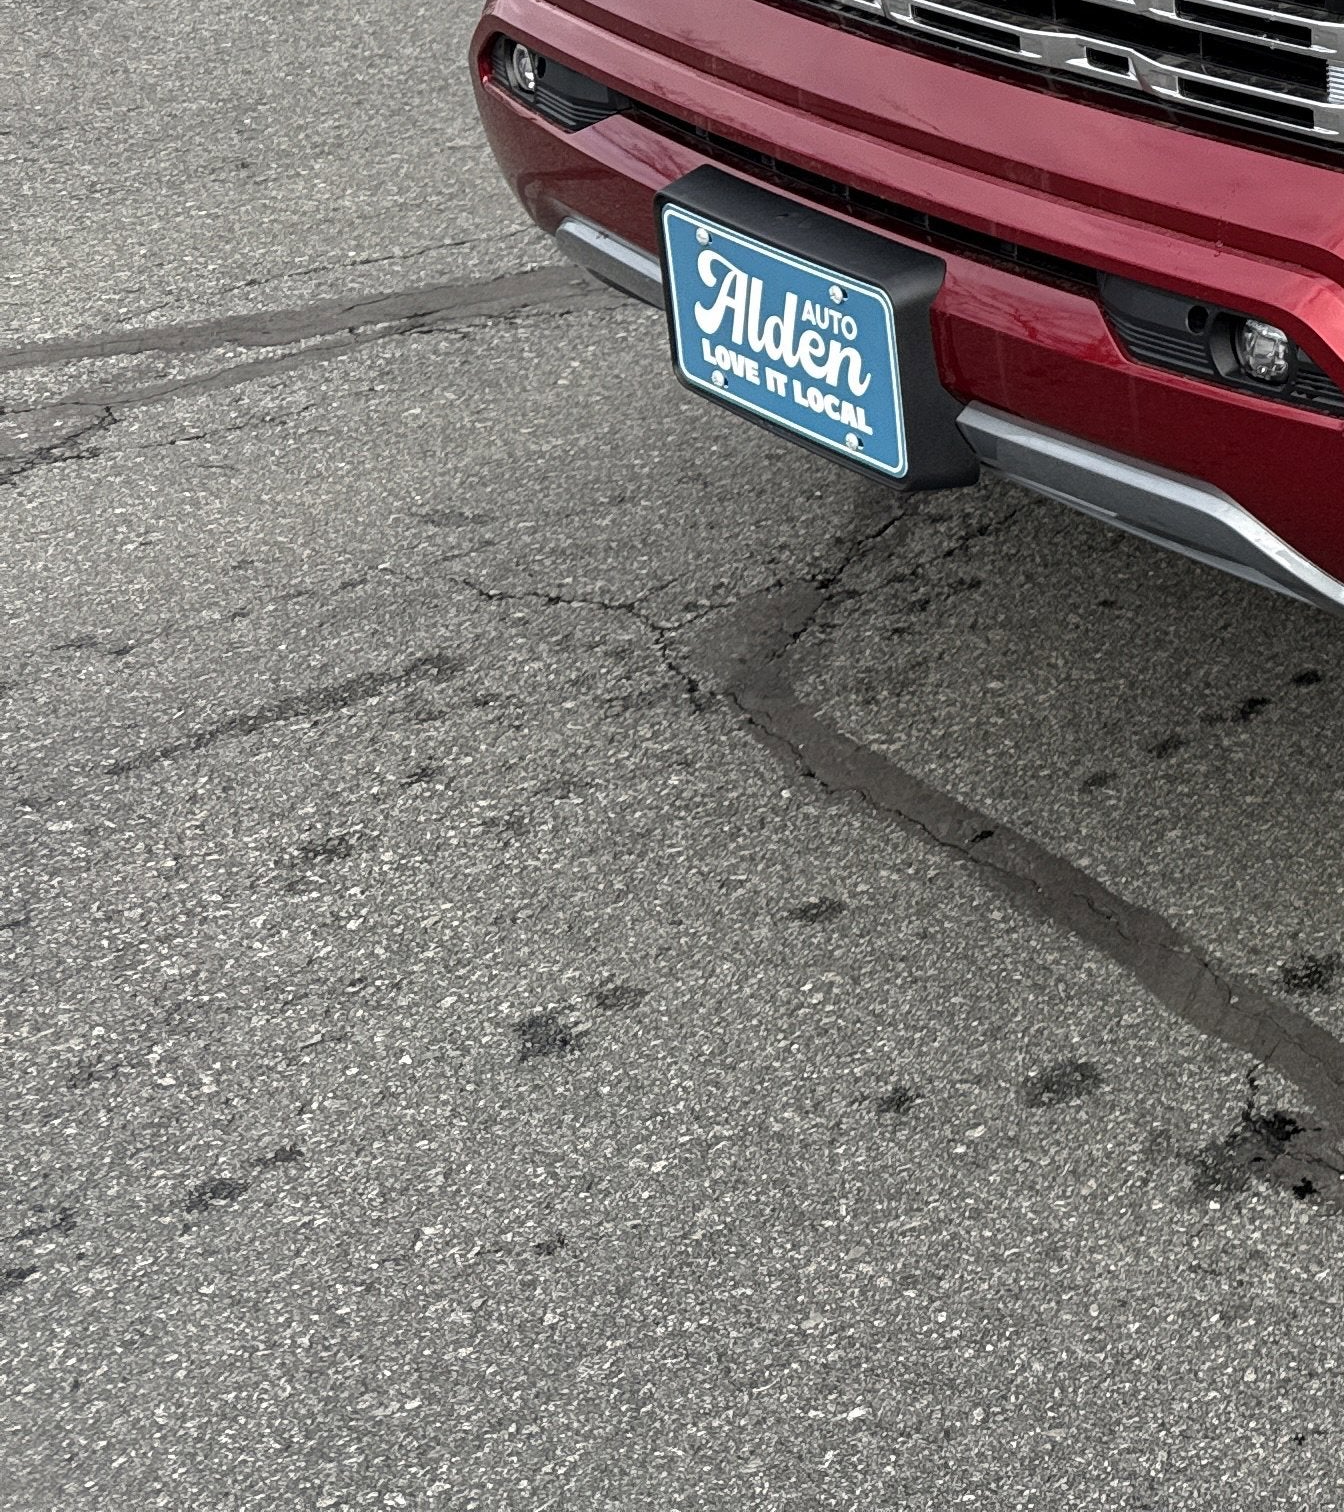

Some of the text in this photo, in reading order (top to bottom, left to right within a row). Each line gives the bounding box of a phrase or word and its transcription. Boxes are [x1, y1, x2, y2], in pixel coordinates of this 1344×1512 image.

[694, 249, 871, 396] Alden
[801, 300, 858, 340] AUTO
[702, 338, 873, 435] LOVE IT LOCAL
